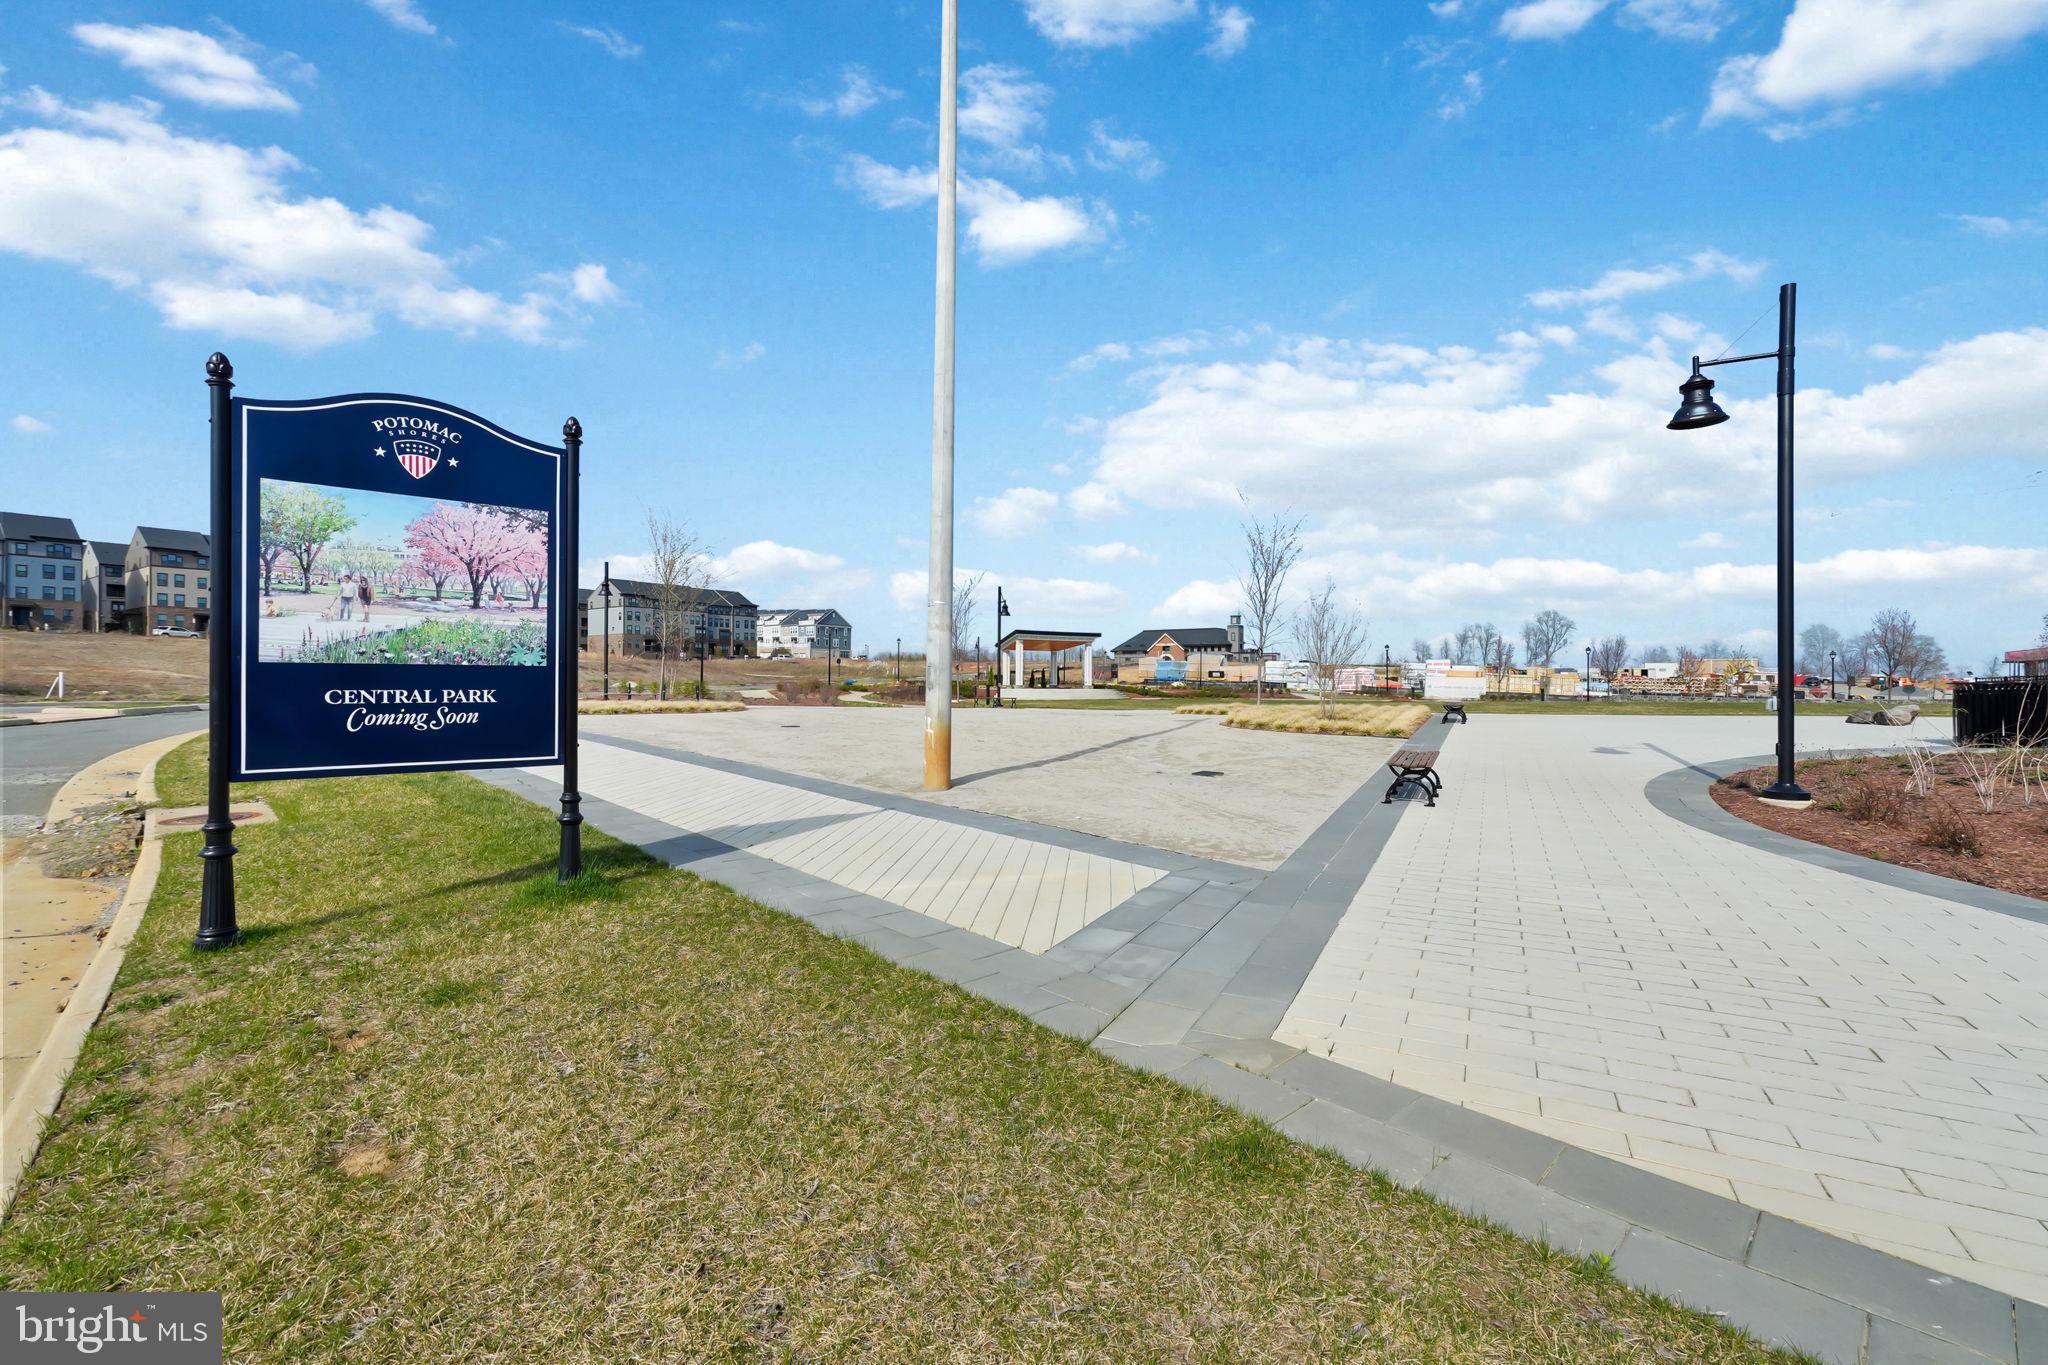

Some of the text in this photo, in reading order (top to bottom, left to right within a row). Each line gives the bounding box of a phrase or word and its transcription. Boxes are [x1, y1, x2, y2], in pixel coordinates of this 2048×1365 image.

[371, 416, 462, 444] POTOMAC
[388, 429, 447, 444] SHORES
[324, 689, 498, 705] CENTRAL PARK
[346, 706, 480, 732] Coming Soon
